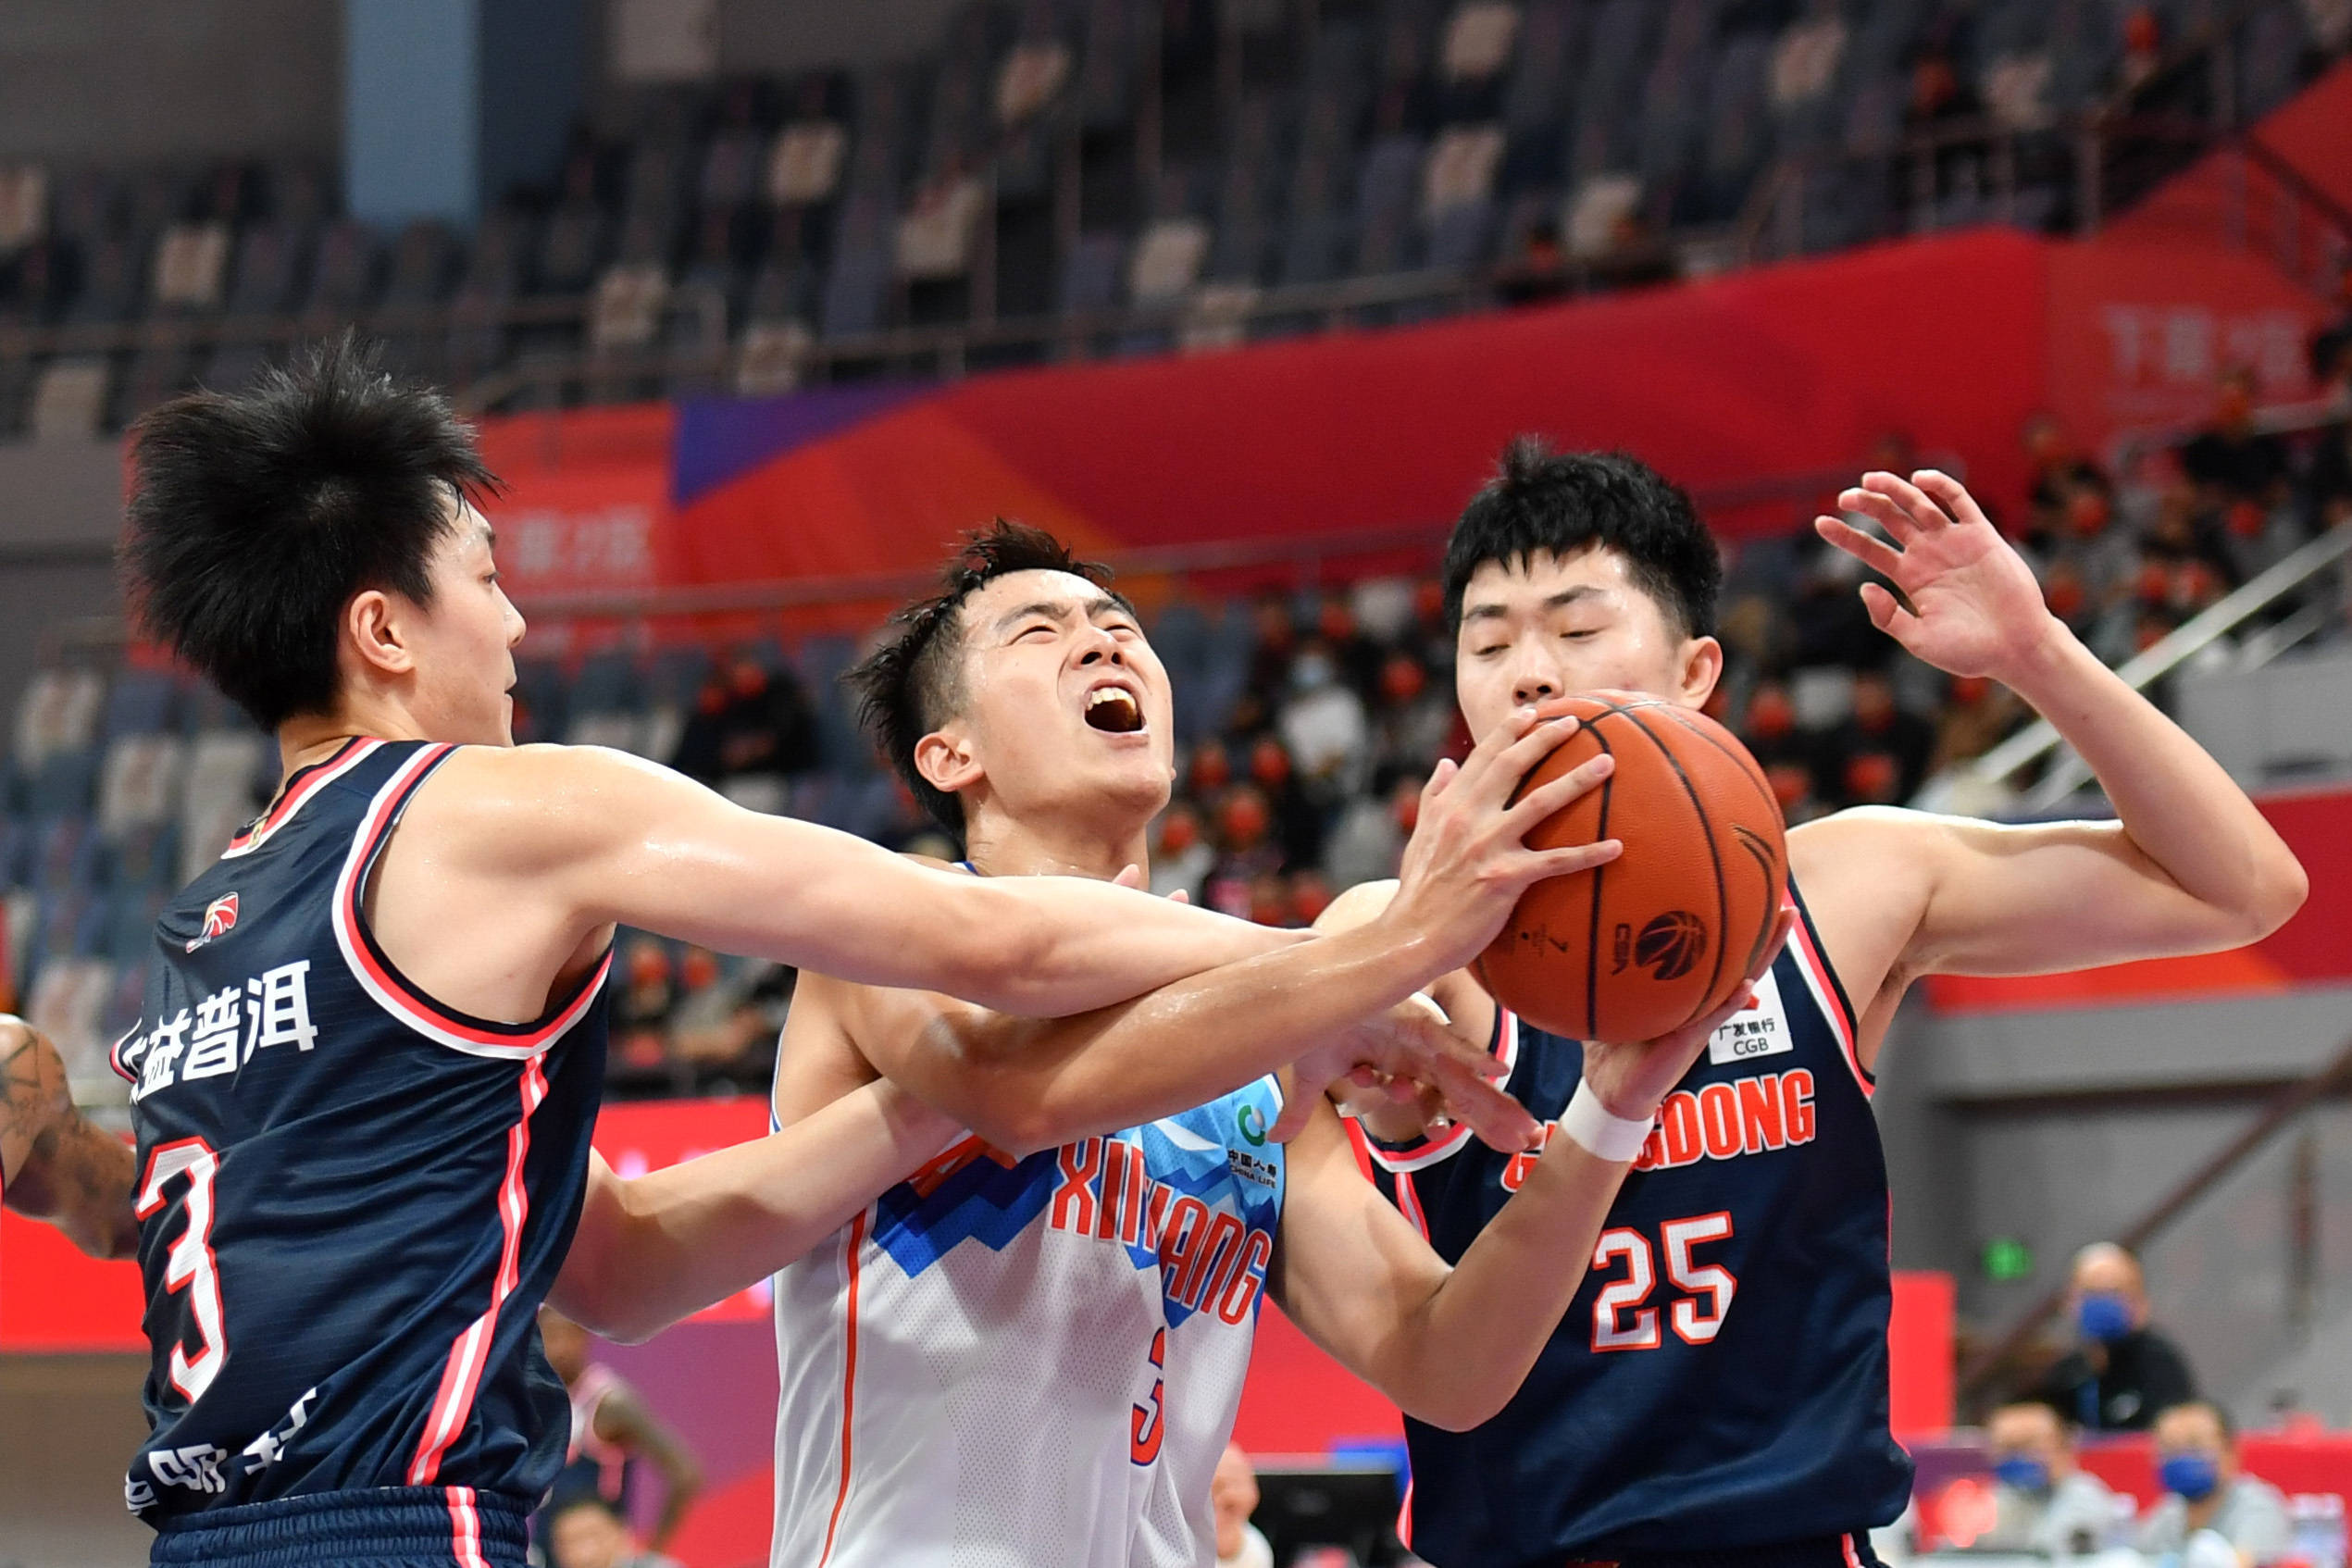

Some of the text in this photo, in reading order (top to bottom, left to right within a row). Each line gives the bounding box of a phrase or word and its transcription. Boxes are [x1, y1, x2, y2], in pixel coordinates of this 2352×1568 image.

[1733, 1037, 1770, 1056] CGB
[134, 1135, 230, 1406] 3
[1590, 1210, 1737, 1353] 25
